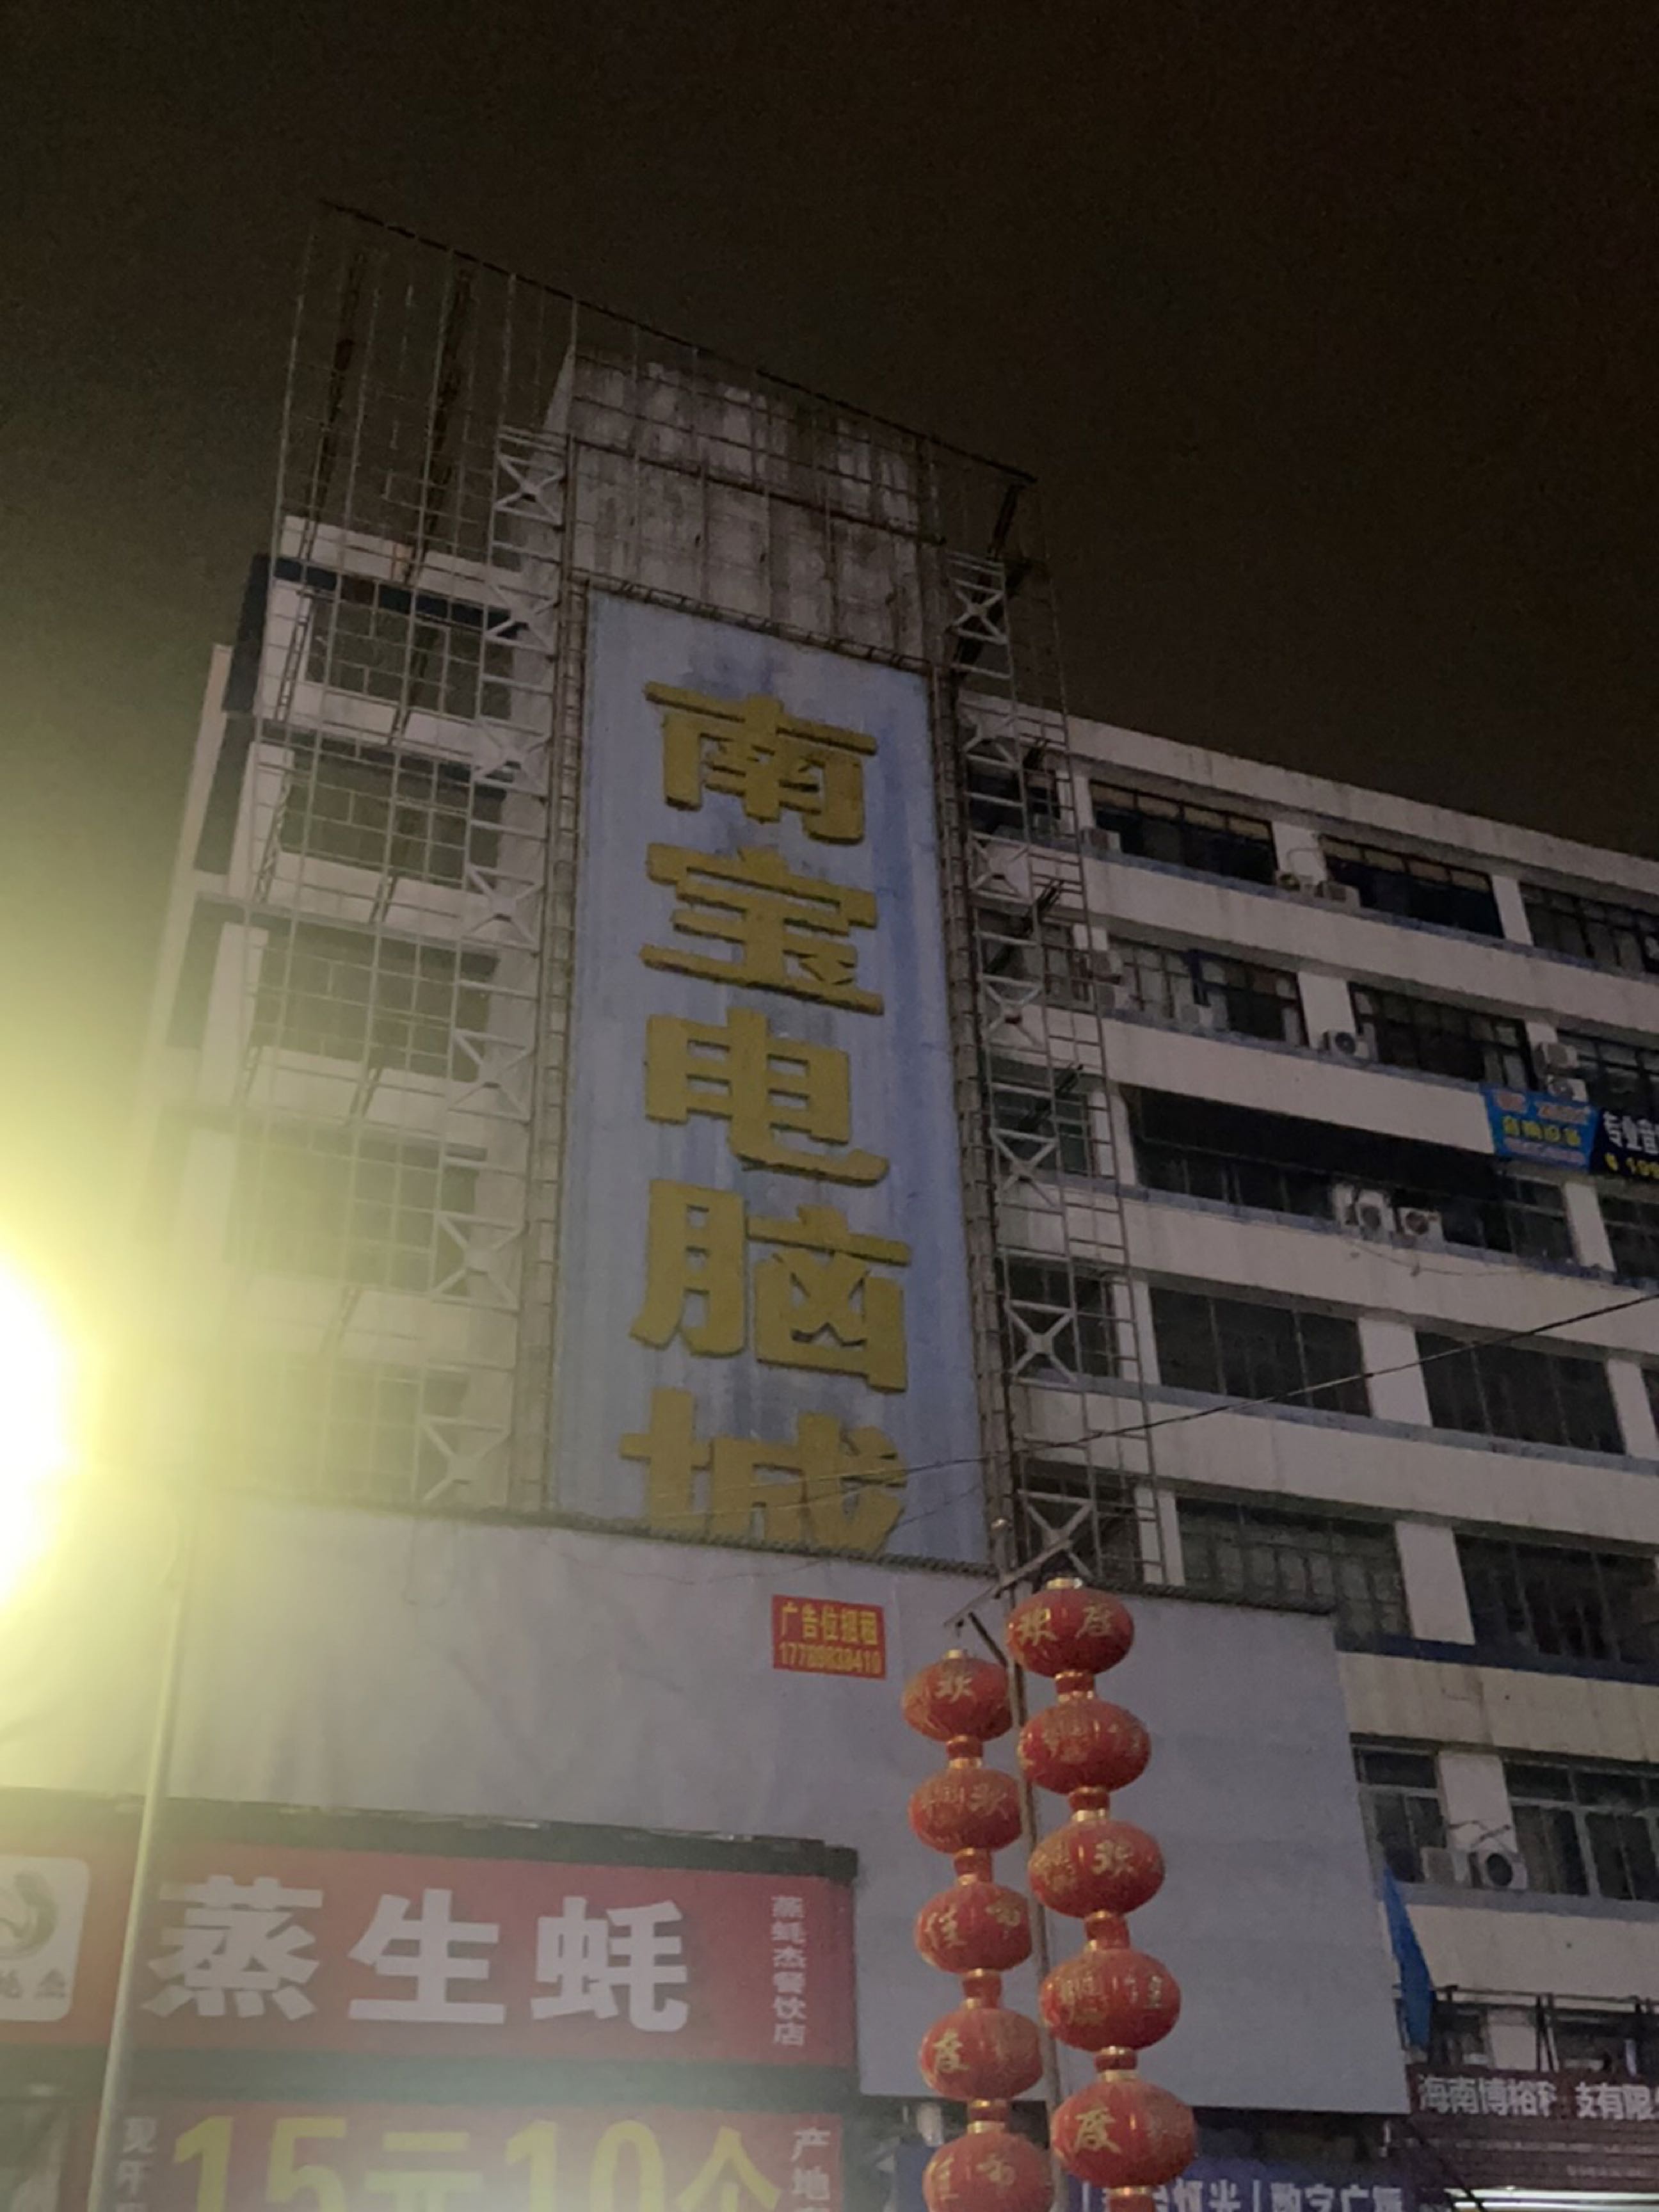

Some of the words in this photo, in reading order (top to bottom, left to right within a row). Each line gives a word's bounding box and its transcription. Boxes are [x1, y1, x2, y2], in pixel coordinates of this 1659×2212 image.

[620, 680, 911, 1553] 南宝电脑城
[142, 1875, 690, 2032] 蒸生蚝
